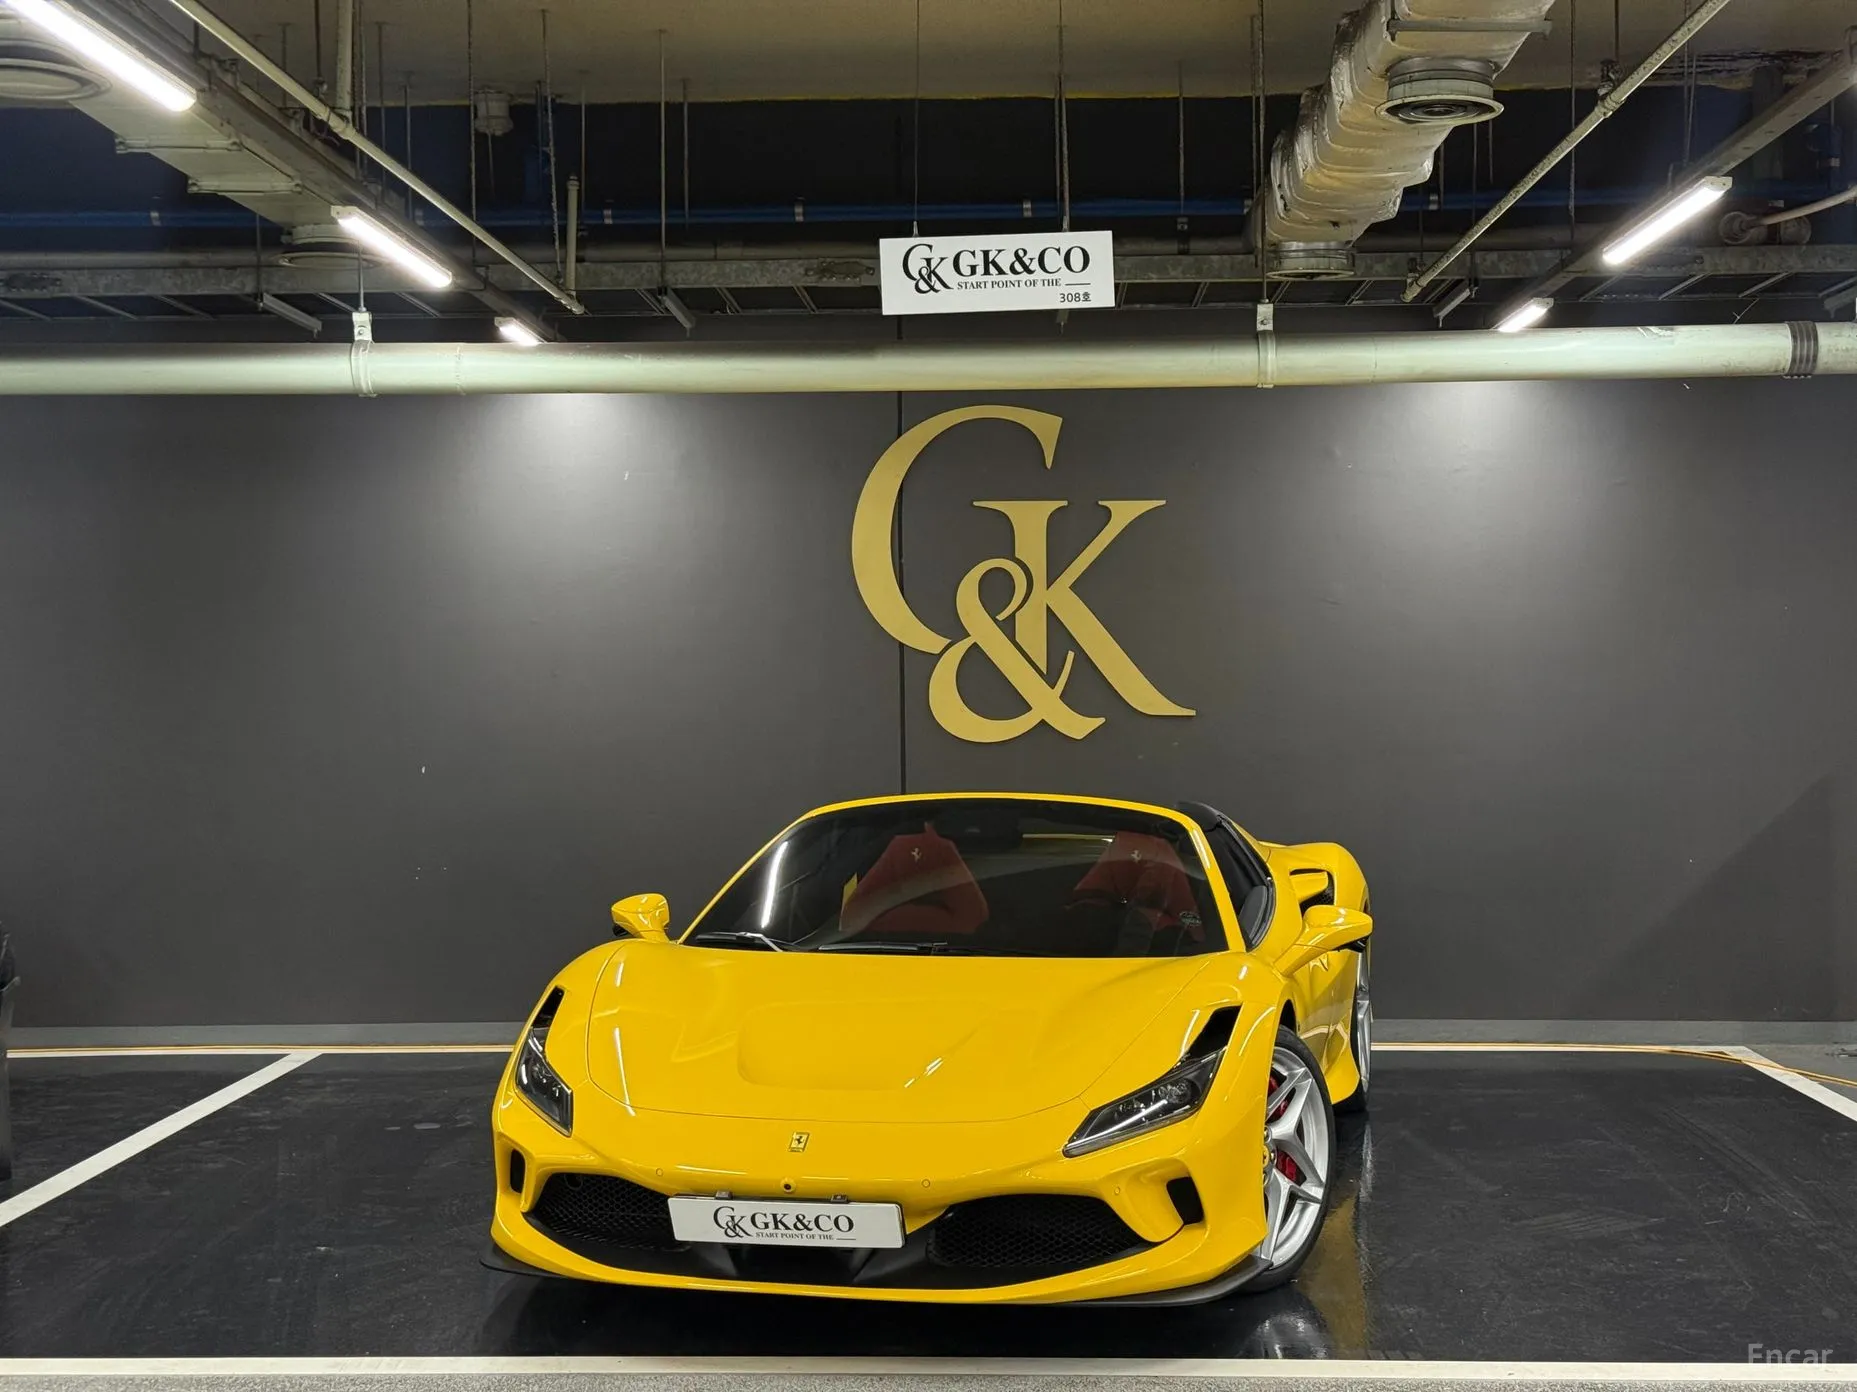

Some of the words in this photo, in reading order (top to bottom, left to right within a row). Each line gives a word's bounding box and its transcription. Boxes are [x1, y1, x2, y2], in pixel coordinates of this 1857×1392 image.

[952, 245, 1090, 277] GK&CO
[957, 280, 988, 290] START
[991, 279, 1022, 289] POINT
[1025, 279, 1040, 288] OF
[1042, 278, 1062, 287] THE
[1059, 291, 1091, 303] 308호
[750, 1211, 854, 1233] GK&CO
[755, 1231, 778, 1239] START
[780, 1232, 804, 1240] POINT
